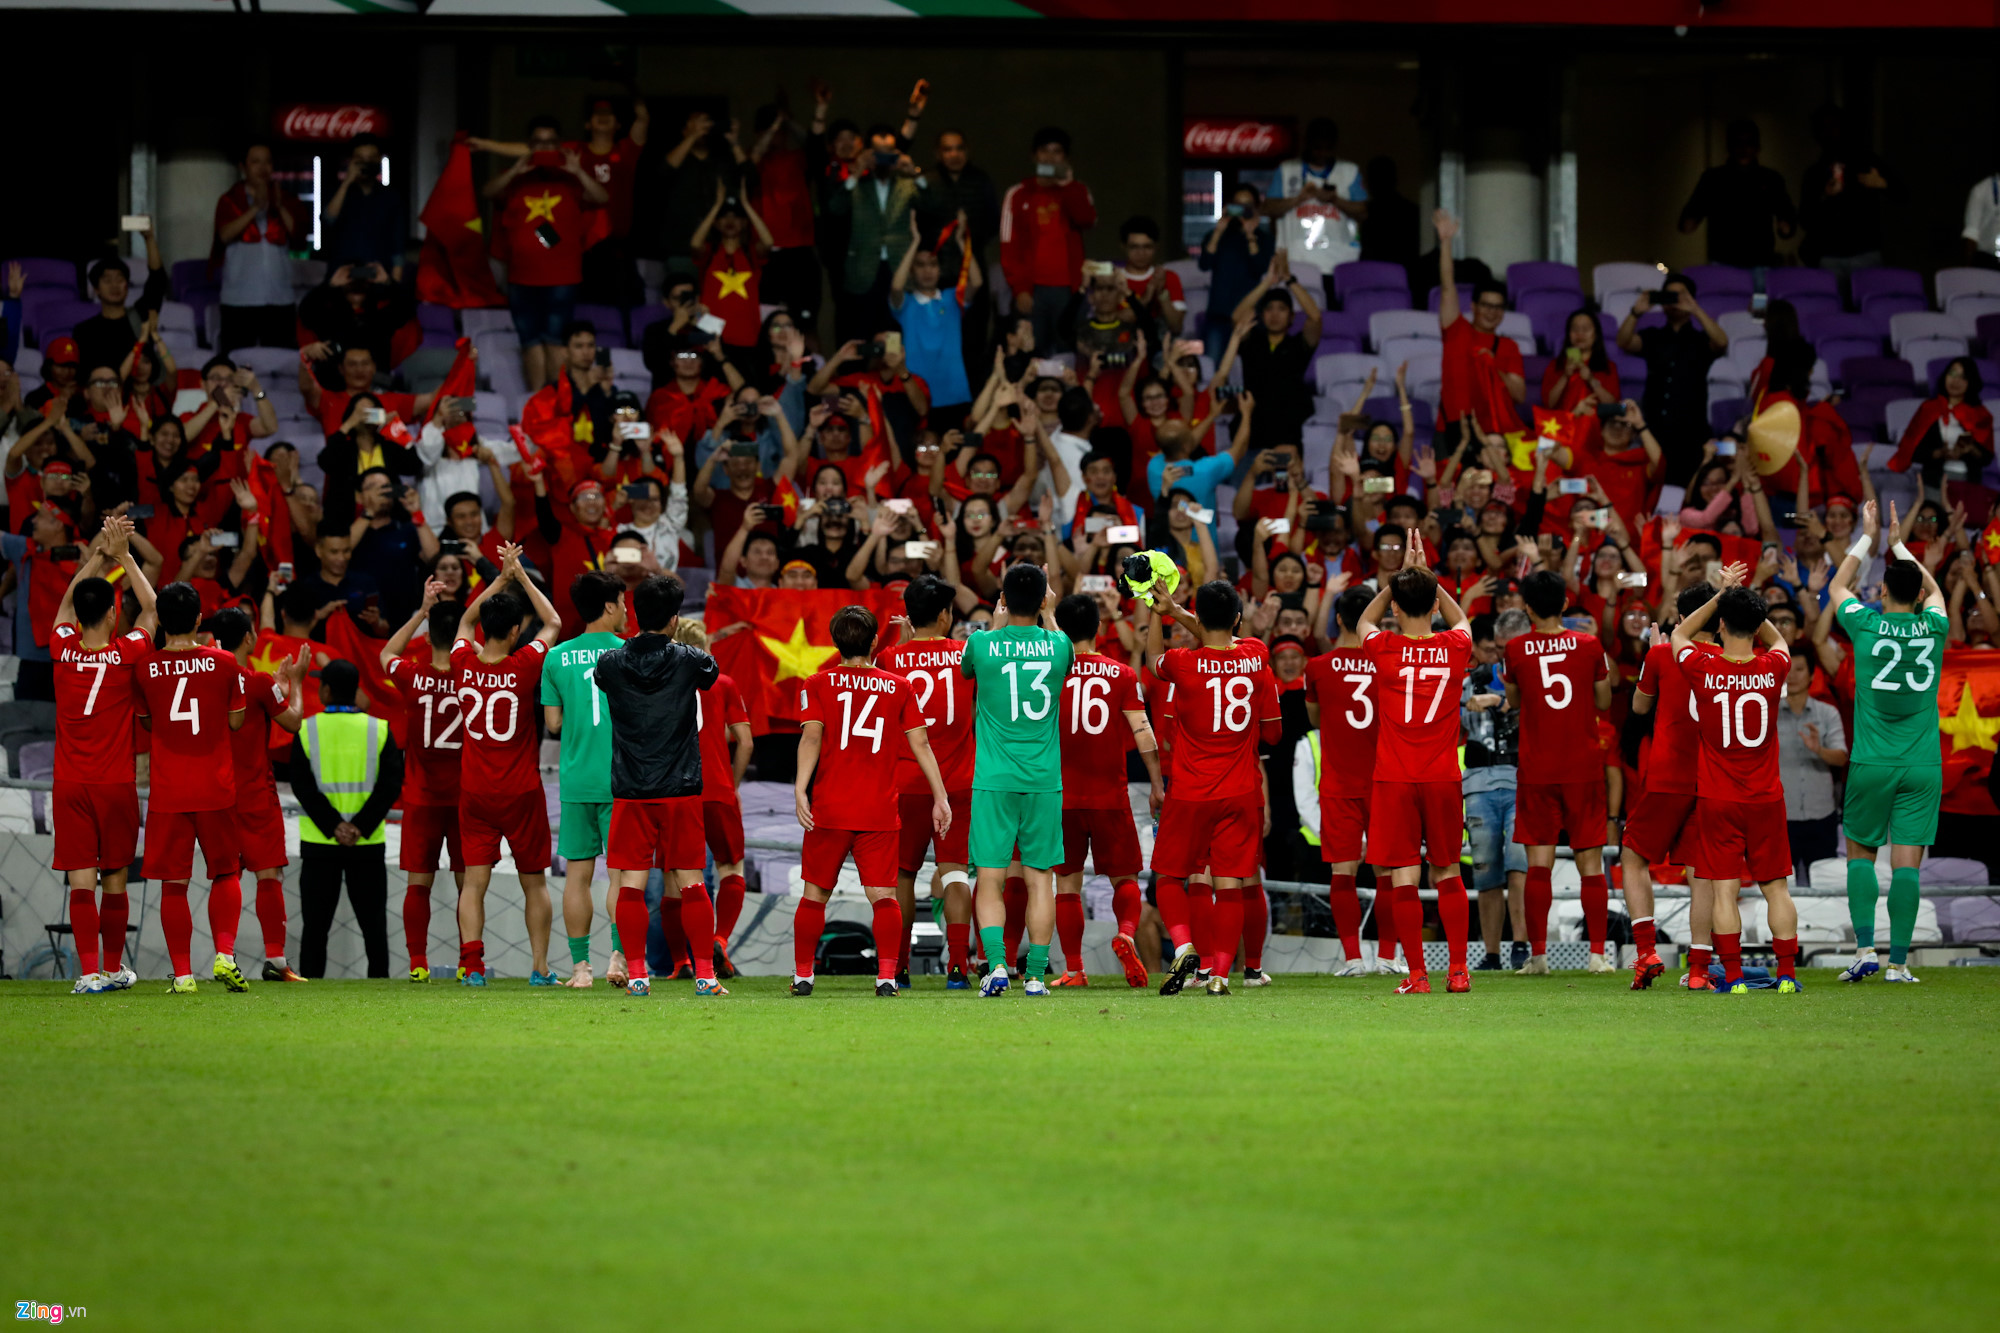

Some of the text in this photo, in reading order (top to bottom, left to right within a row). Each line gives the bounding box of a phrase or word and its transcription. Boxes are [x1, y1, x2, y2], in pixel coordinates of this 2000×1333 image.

[989, 640, 1055, 657] N.T.MANH
[1402, 646, 1448, 664] H.T.TAI
[1523, 637, 1577, 656] D.V.HAU
[1878, 620, 1929, 637] D.V.LAM
[149, 656, 216, 678] B.T.DUNG
[462, 668, 517, 688] P.V.DUC
[561, 649, 596, 667] B.TIEN
[828, 673, 896, 694] T.M.VUONG
[895, 650, 962, 668] N.T.CHUNG
[1197, 655, 1262, 674] H.D.CHINH
[1331, 657, 1377, 673] Q.N.HA
[1538, 653, 1573, 709] 5
[1704, 672, 1776, 690] N.C.PHUONG
[1871, 638, 1935, 692] 23
[77, 662, 107, 716] 7
[170, 677, 200, 736] 4
[458, 687, 519, 742] 20
[905, 668, 954, 726] 21
[1001, 661, 1052, 722] 13
[1066, 677, 1110, 735] 16
[1205, 676, 1254, 733] 18
[1343, 674, 1374, 730] 3
[1399, 666, 1451, 723] 17
[418, 694, 464, 749] 12
[837, 691, 885, 754] 14
[1713, 692, 1769, 749] 10
